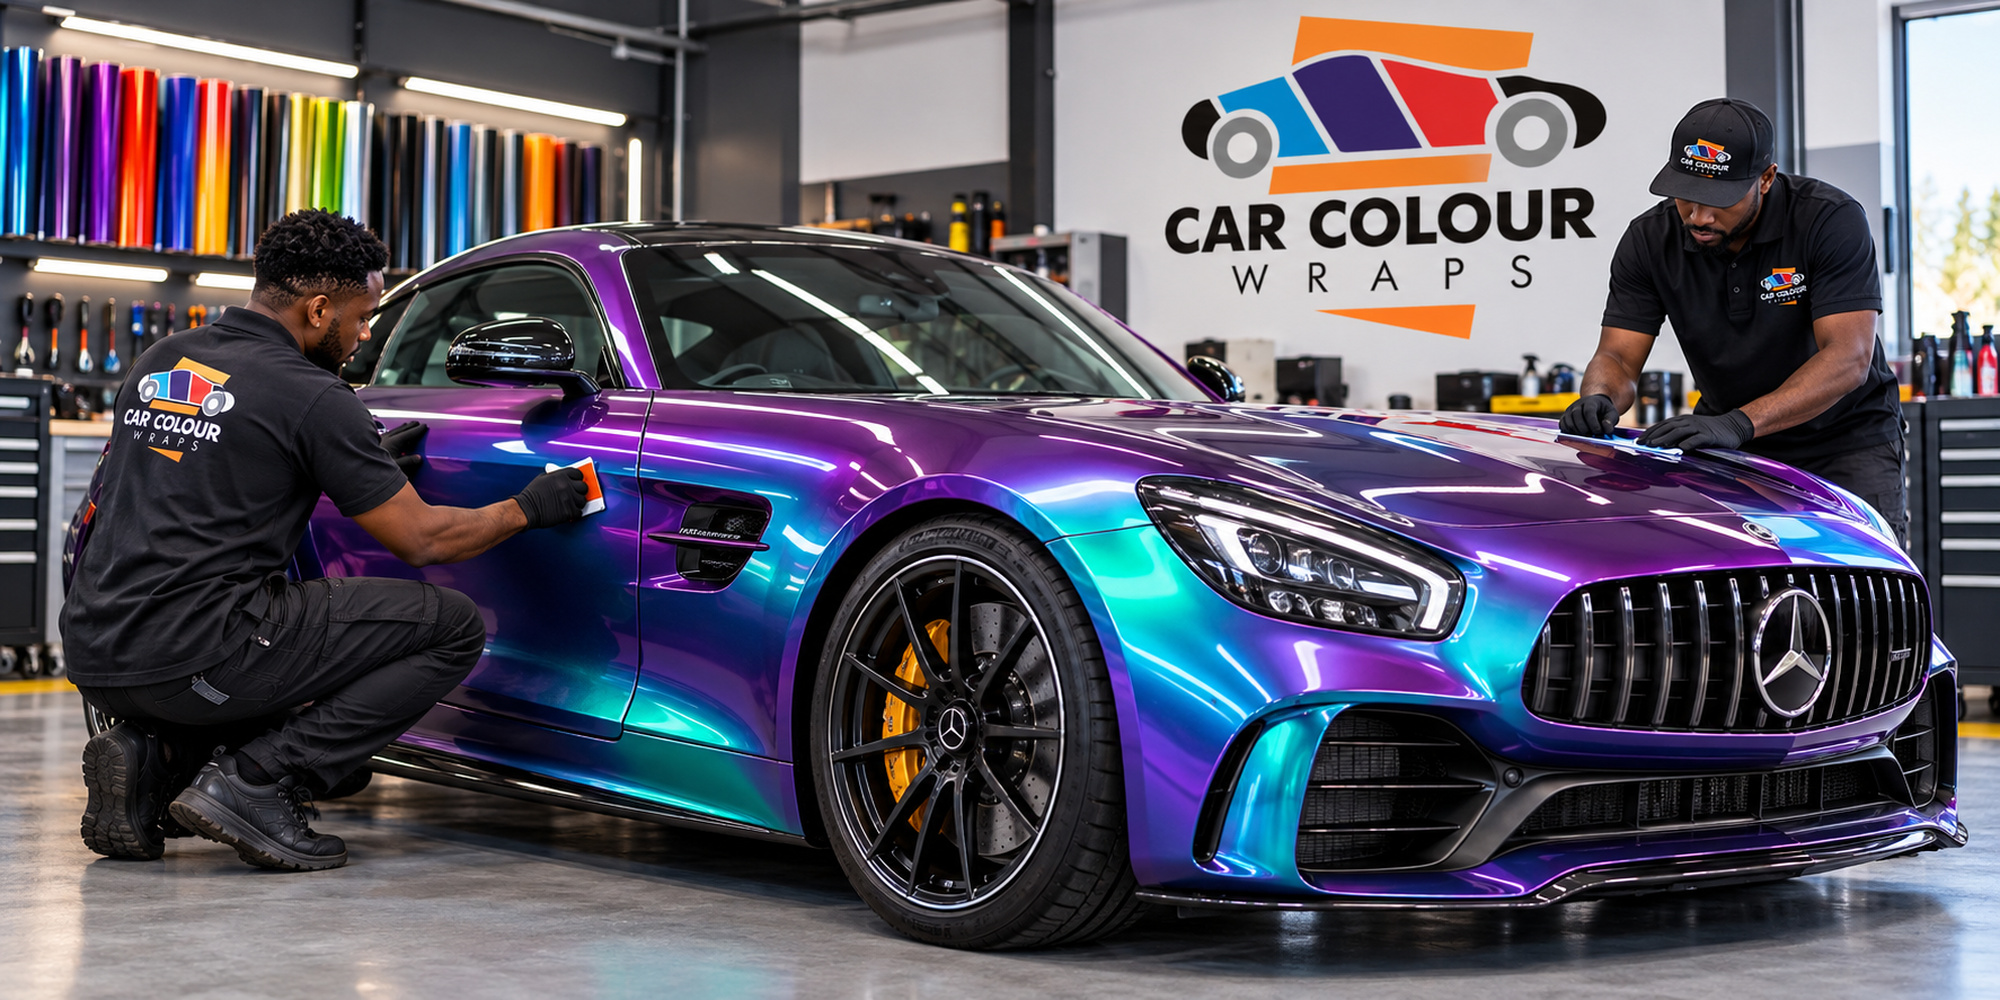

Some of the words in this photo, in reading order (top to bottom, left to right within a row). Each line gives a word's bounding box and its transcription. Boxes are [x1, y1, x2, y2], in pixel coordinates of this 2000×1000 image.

[1165, 203, 1287, 254] CAR
[1309, 187, 1597, 249] COLOUR
[1231, 254, 1533, 295] WRAPS
[124, 408, 152, 428] CAR
[153, 413, 221, 443] COLOUR
[133, 430, 200, 452] WRAPS
